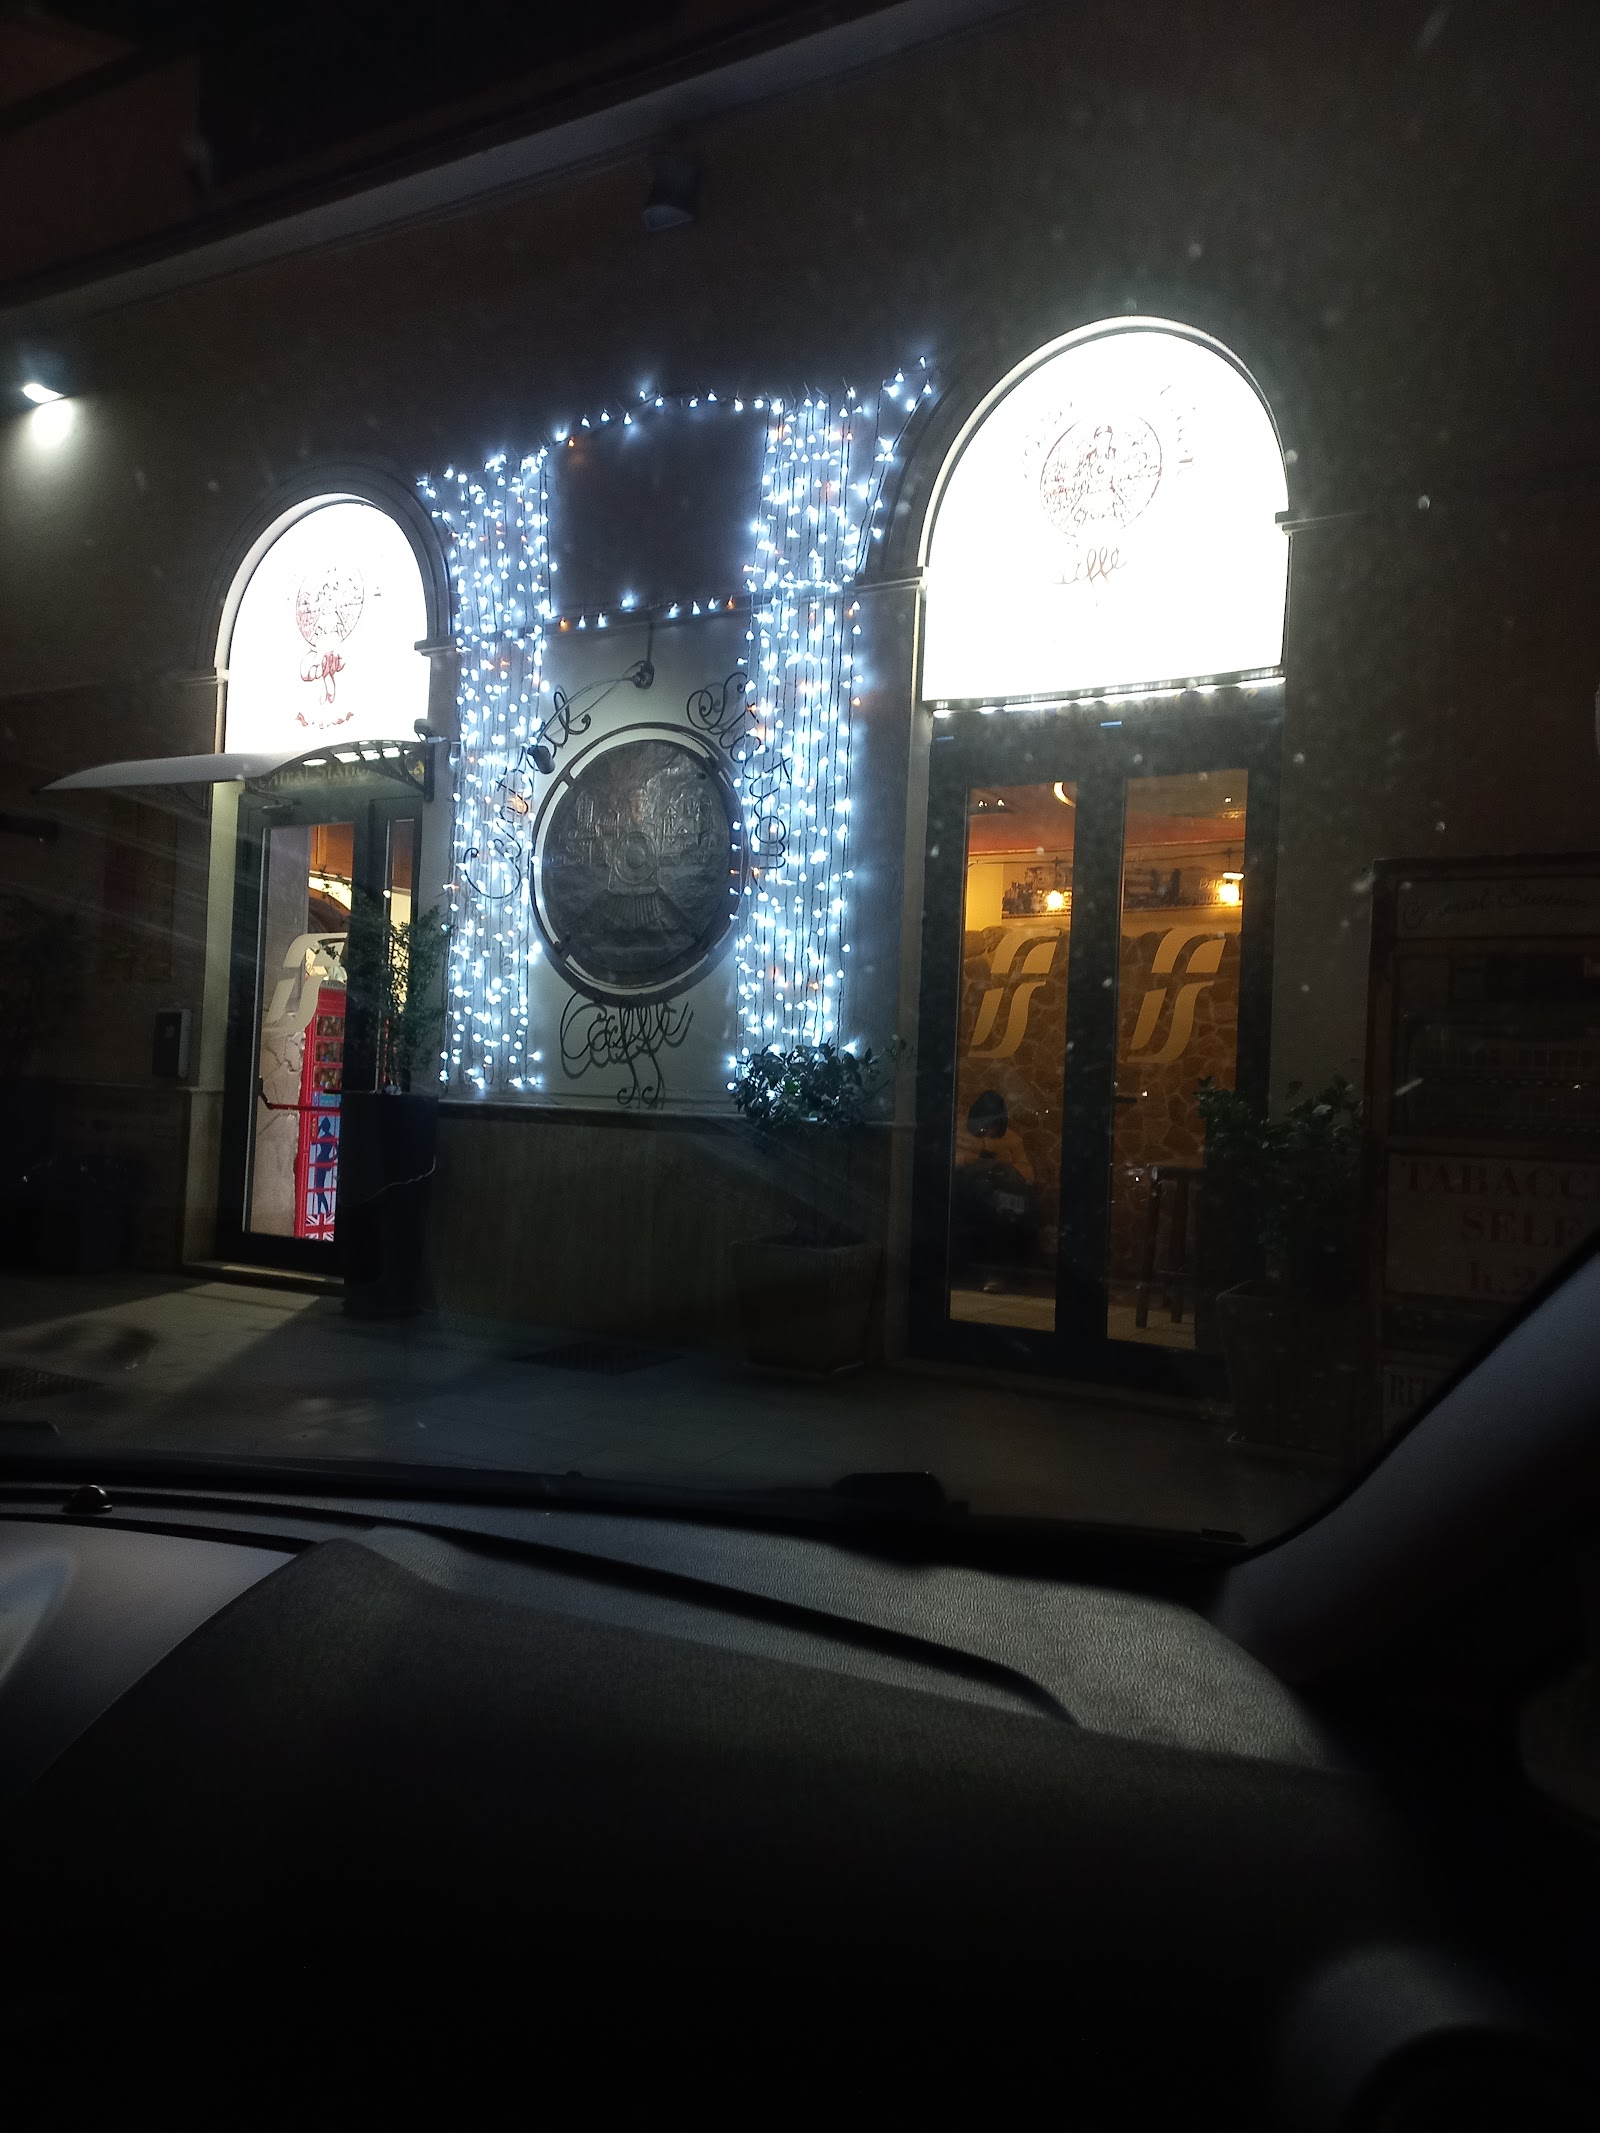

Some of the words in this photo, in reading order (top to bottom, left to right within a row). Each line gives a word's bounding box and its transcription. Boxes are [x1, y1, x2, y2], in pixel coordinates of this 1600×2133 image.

[1199, 877, 1223, 890] Bar
[1401, 1161, 1600, 1201] TABACC
[1460, 1208, 1582, 1248] SELF
